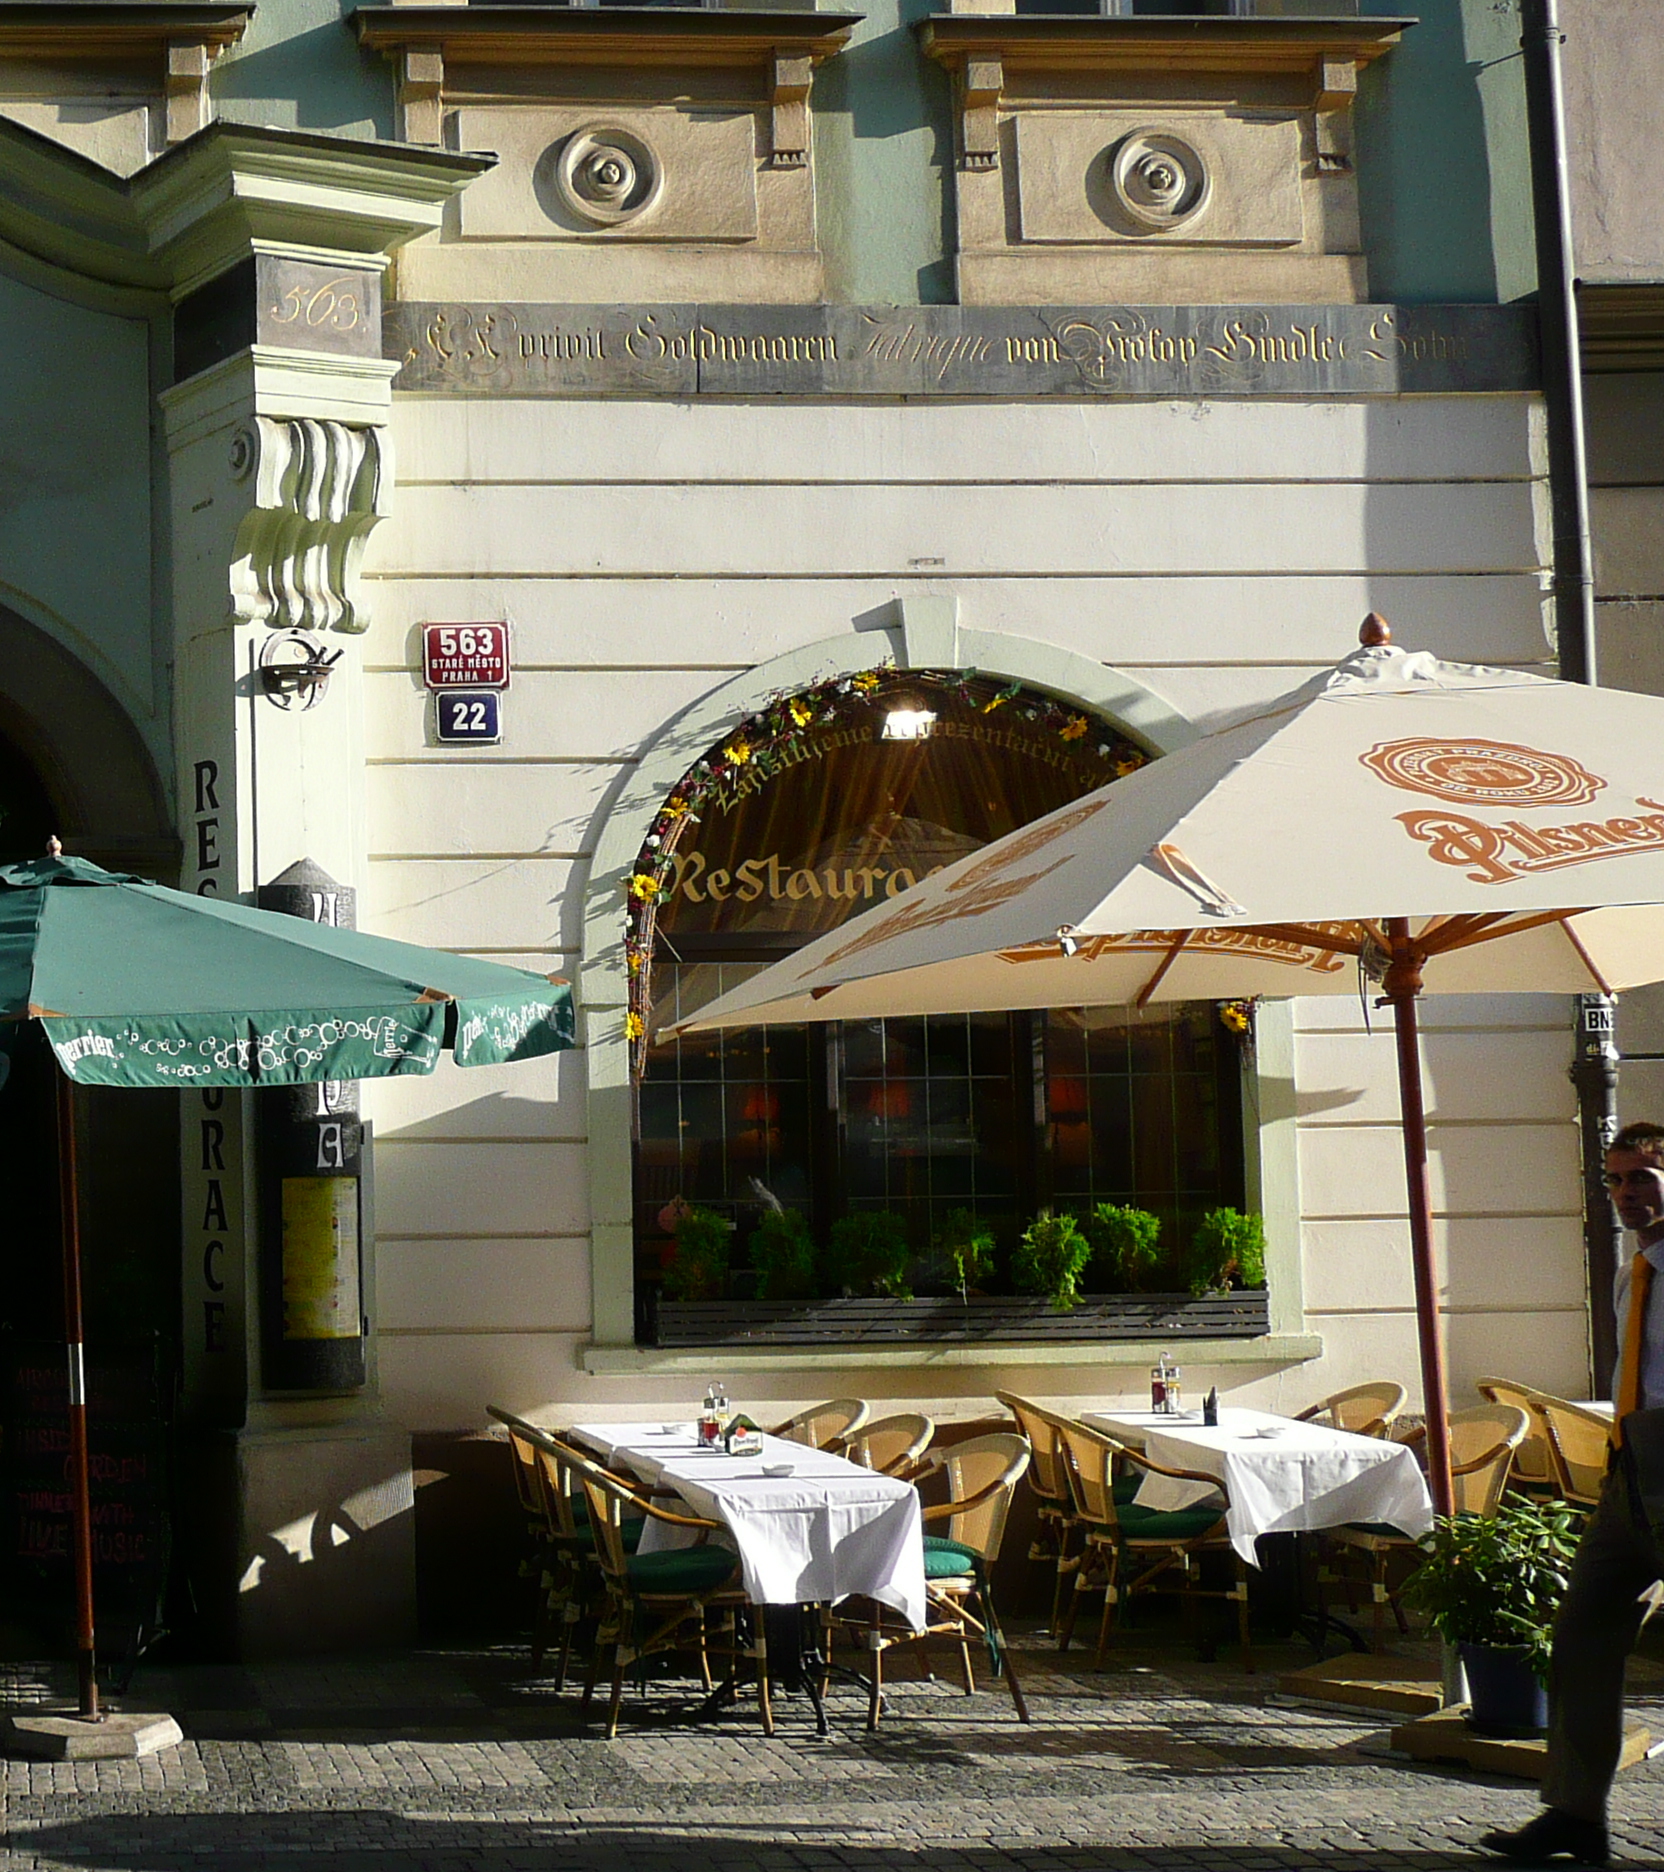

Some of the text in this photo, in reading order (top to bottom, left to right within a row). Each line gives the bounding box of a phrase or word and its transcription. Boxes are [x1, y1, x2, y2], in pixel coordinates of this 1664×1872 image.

[1004, 334, 1062, 364] von
[439, 628, 494, 656] 563
[431, 654, 502, 669] STARÉ MĚSTO
[442, 670, 493, 682] PRAHA 1
[452, 702, 487, 731] 22
[1588, 1011, 1614, 1030] BN
